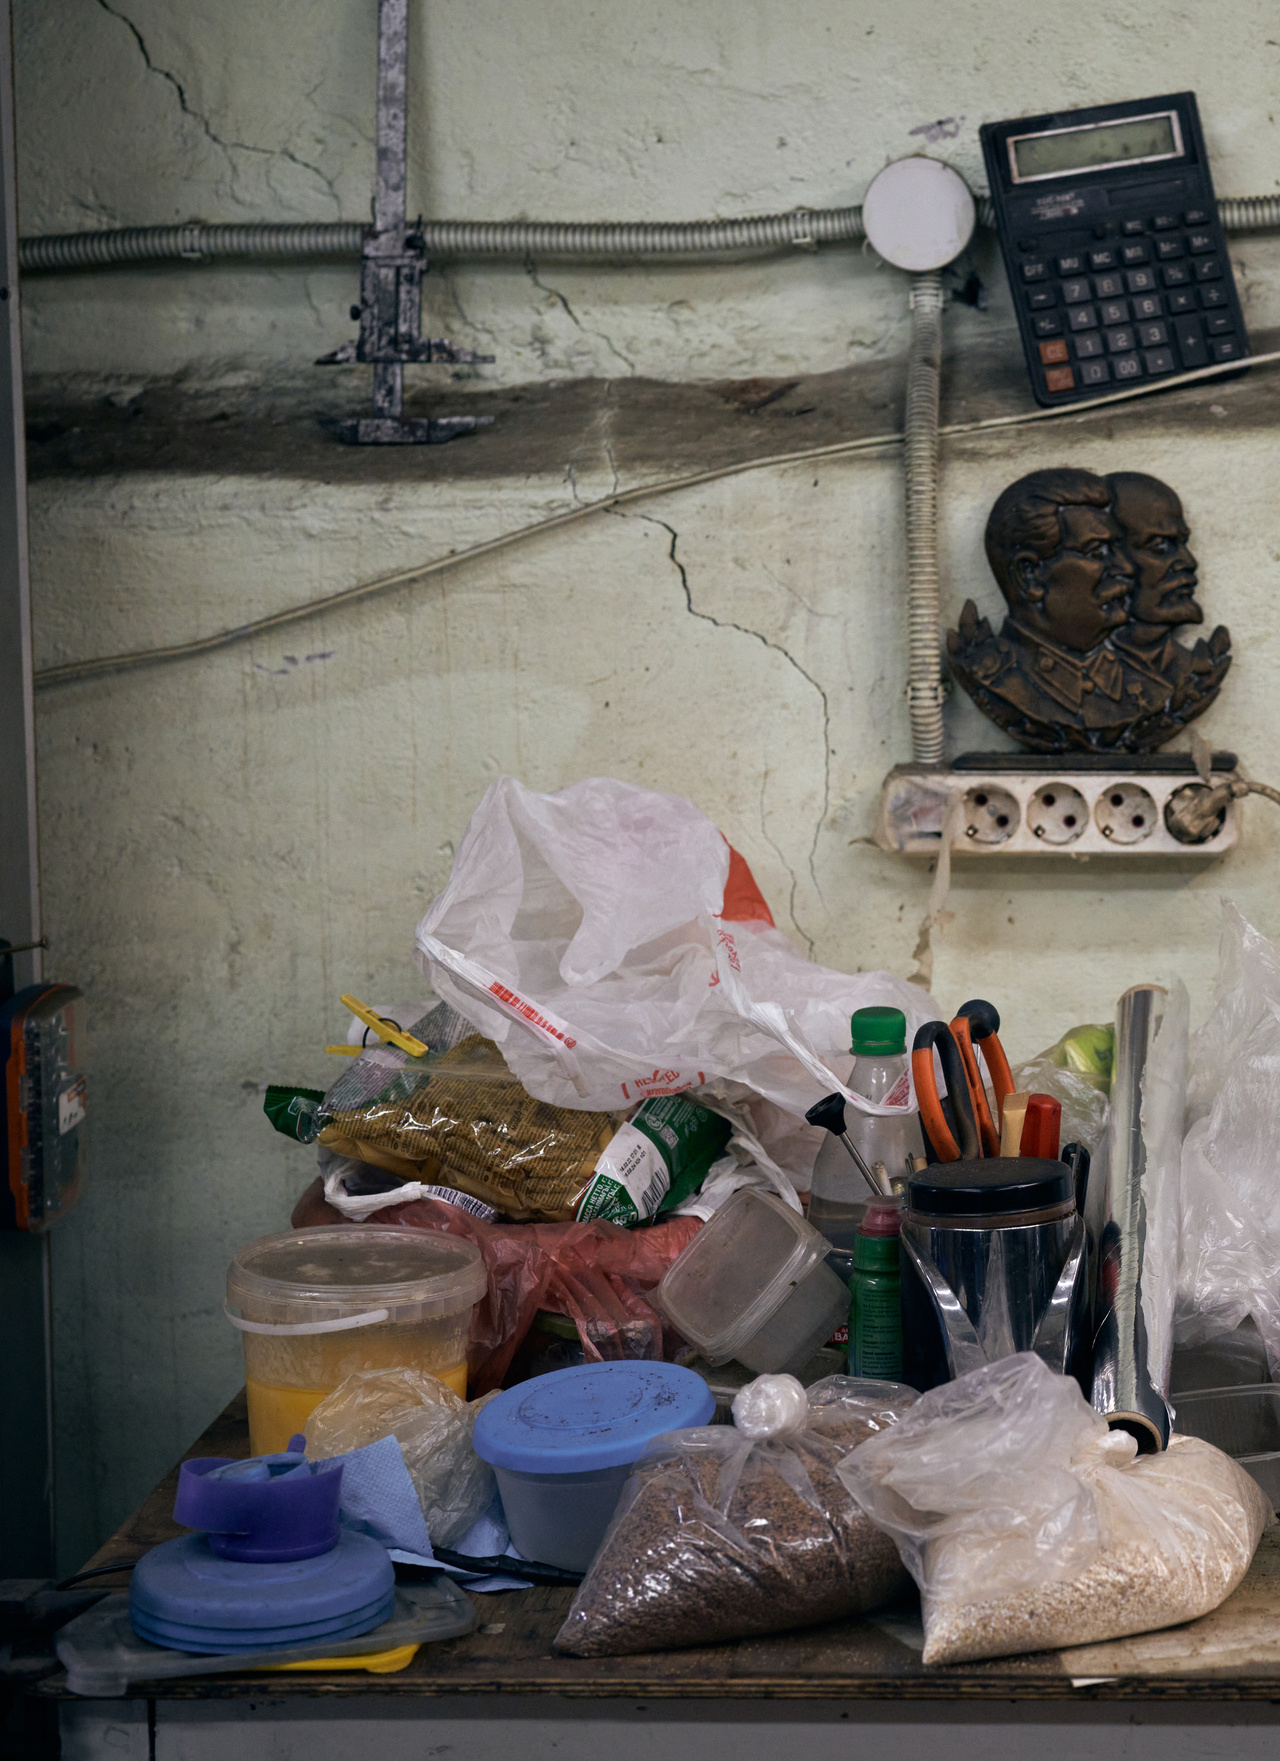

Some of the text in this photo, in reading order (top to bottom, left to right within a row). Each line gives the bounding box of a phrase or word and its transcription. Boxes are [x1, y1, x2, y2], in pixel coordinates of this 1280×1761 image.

[1093, 252, 1112, 264] MC
[1070, 284, 1081, 298] 7
[1102, 279, 1114, 293] 8
[1135, 273, 1147, 287] 9
[1077, 311, 1088, 323] 4
[1108, 306, 1121, 319] 5
[1142, 300, 1154, 313] 6
[1085, 339, 1093, 353] 1
[1115, 333, 1128, 347] 2
[1149, 327, 1161, 341] 3
[1089, 365, 1102, 379] 0
[1119, 360, 1138, 375] 00
